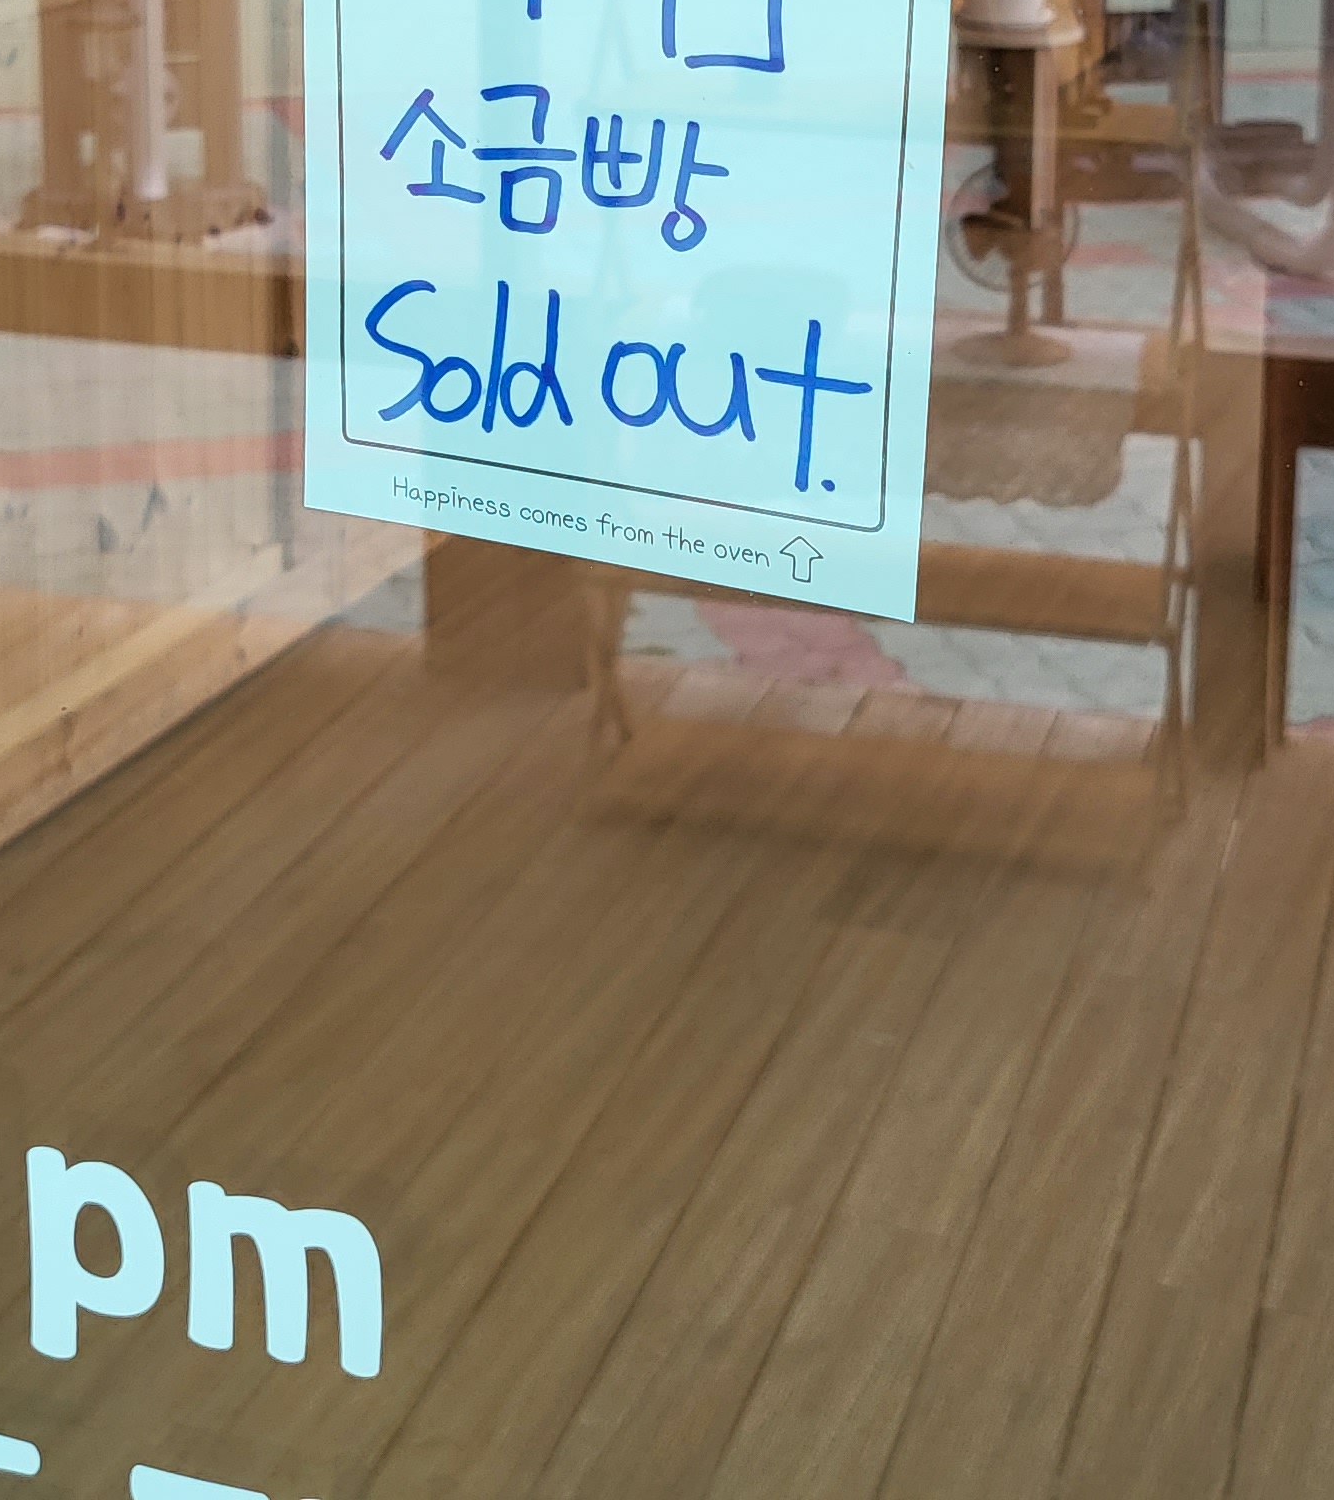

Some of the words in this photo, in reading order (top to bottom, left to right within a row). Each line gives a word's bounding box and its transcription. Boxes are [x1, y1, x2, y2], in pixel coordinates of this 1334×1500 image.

[379, 83, 730, 253] 소금빵
[364, 279, 574, 434] Sold
[392, 475, 511, 519] Happiness
[519, 506, 589, 532] comes
[595, 512, 655, 546] from
[661, 525, 706, 554] the
[713, 543, 771, 568] oven
